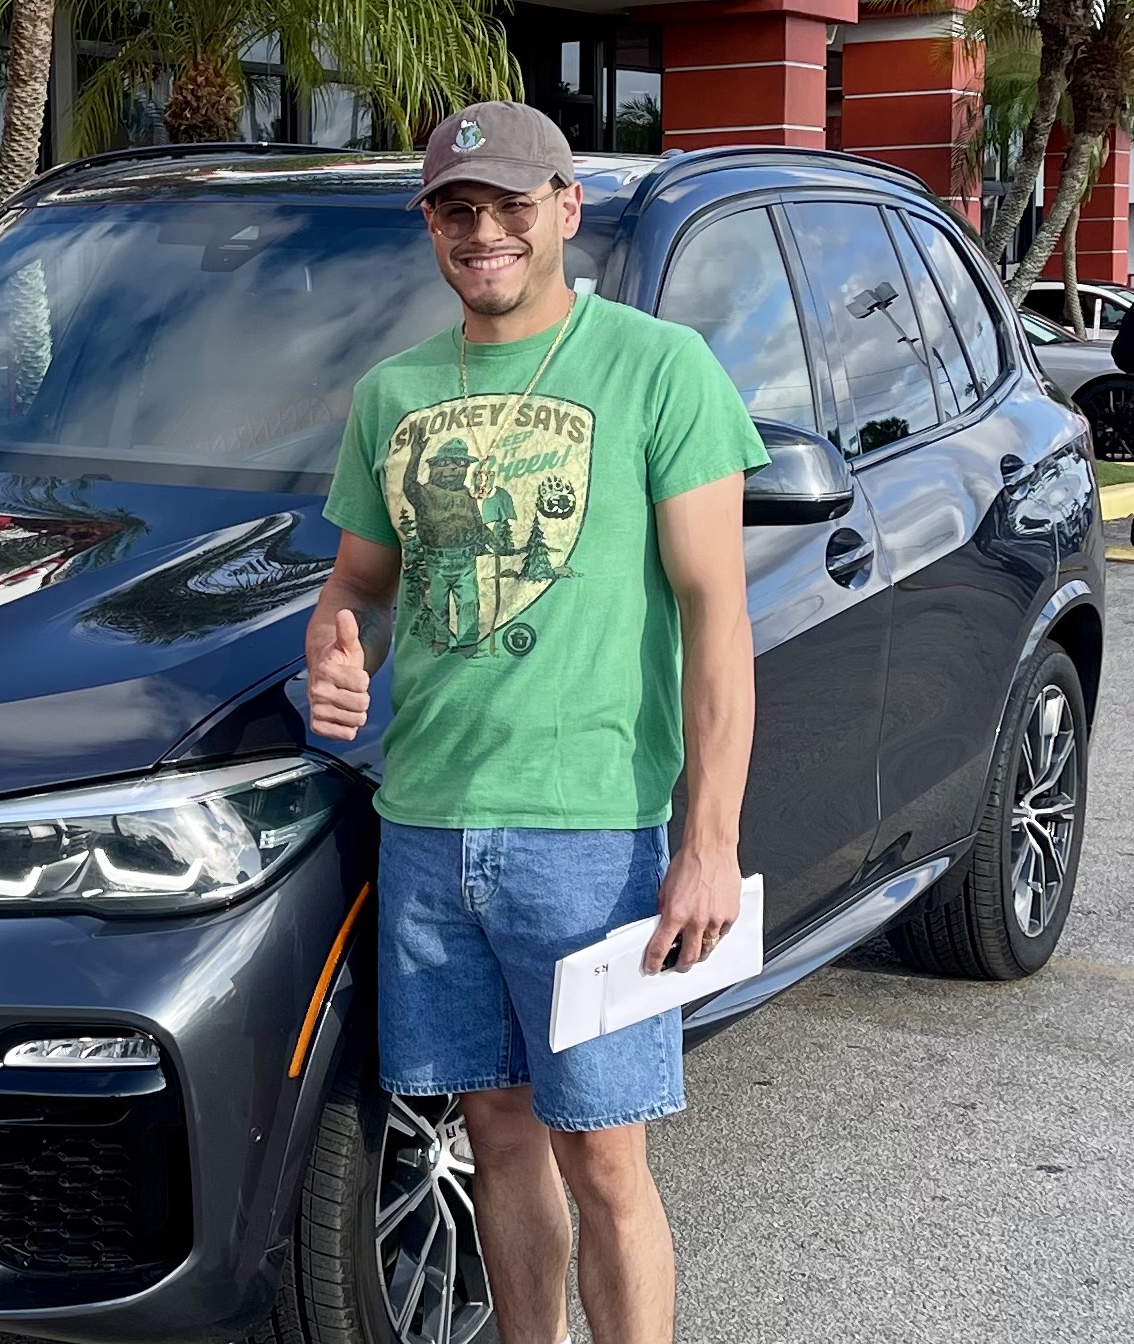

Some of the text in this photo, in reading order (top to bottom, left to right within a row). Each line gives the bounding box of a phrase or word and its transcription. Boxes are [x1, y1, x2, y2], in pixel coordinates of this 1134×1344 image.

[392, 402, 586, 454] SMOKEY SAYS
[495, 429, 534, 449] EEP
[502, 445, 522, 460] IT
